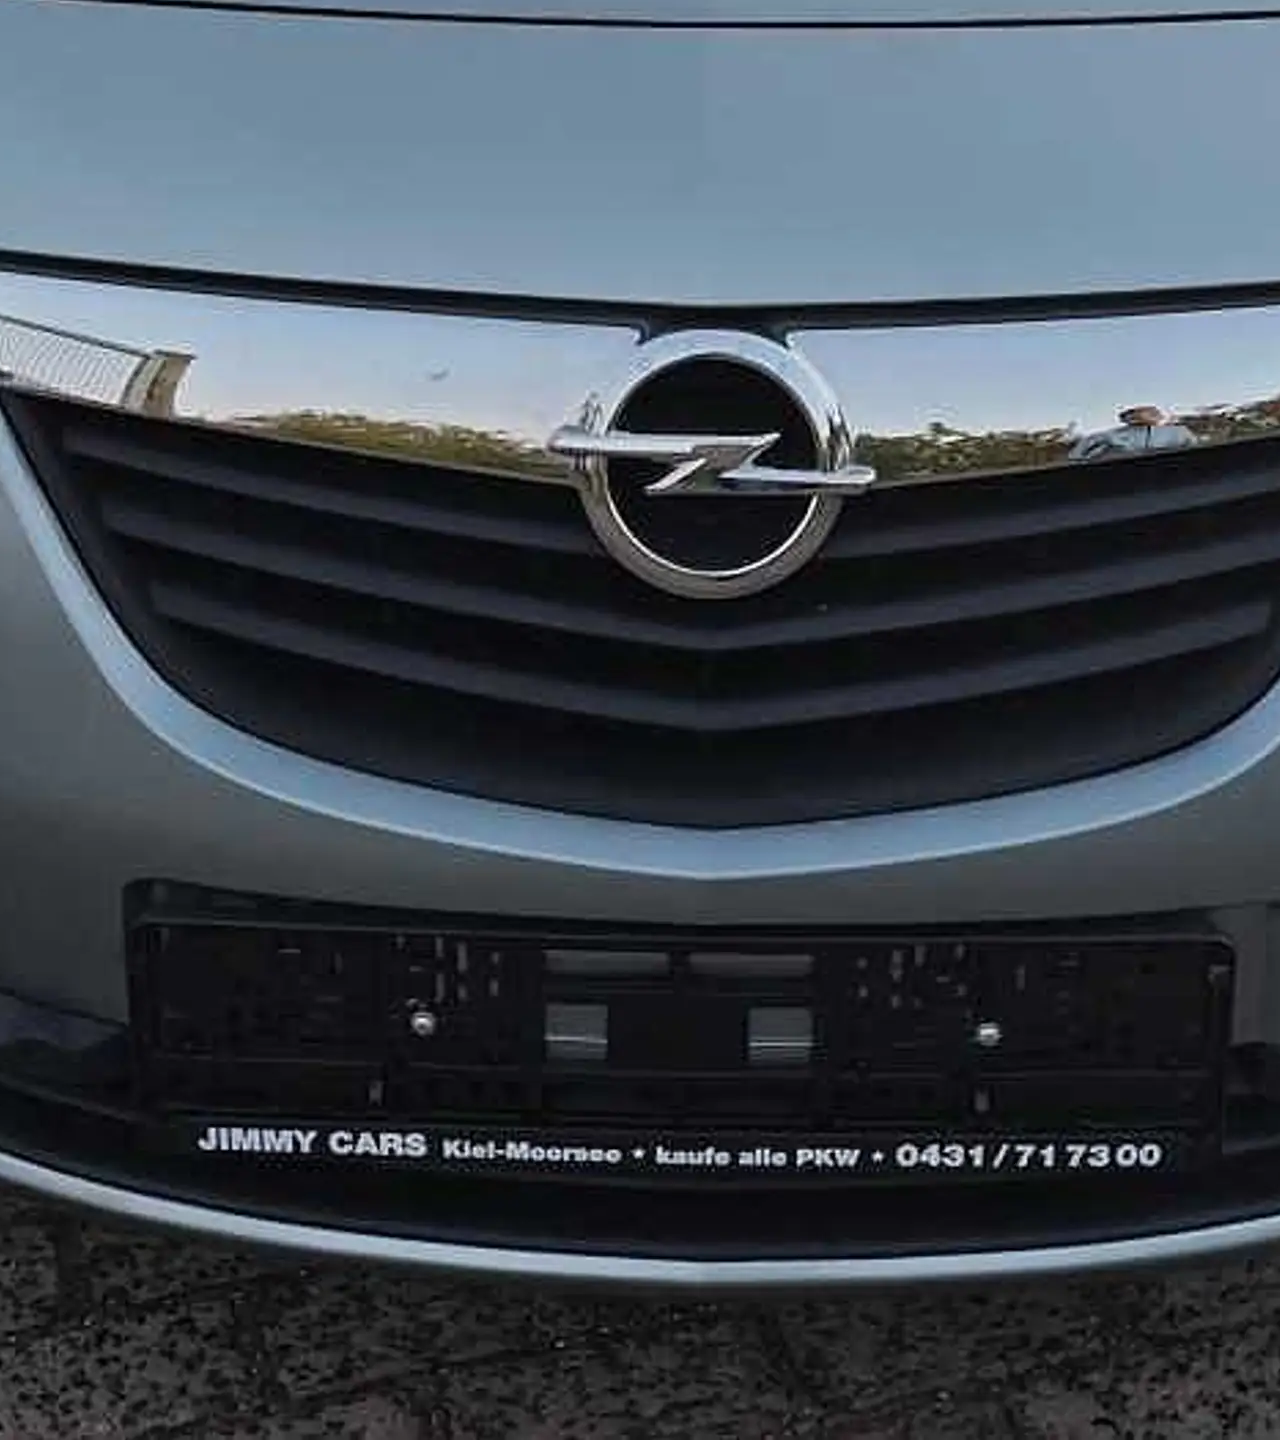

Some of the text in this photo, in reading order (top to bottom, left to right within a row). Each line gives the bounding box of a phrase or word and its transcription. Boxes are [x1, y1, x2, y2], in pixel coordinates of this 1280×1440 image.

[197, 1127, 317, 1153] JIMMY
[328, 1130, 427, 1156] CARS
[655, 1145, 730, 1166] kaufe
[738, 1148, 787, 1167] alle
[795, 1148, 861, 1167] PKW
